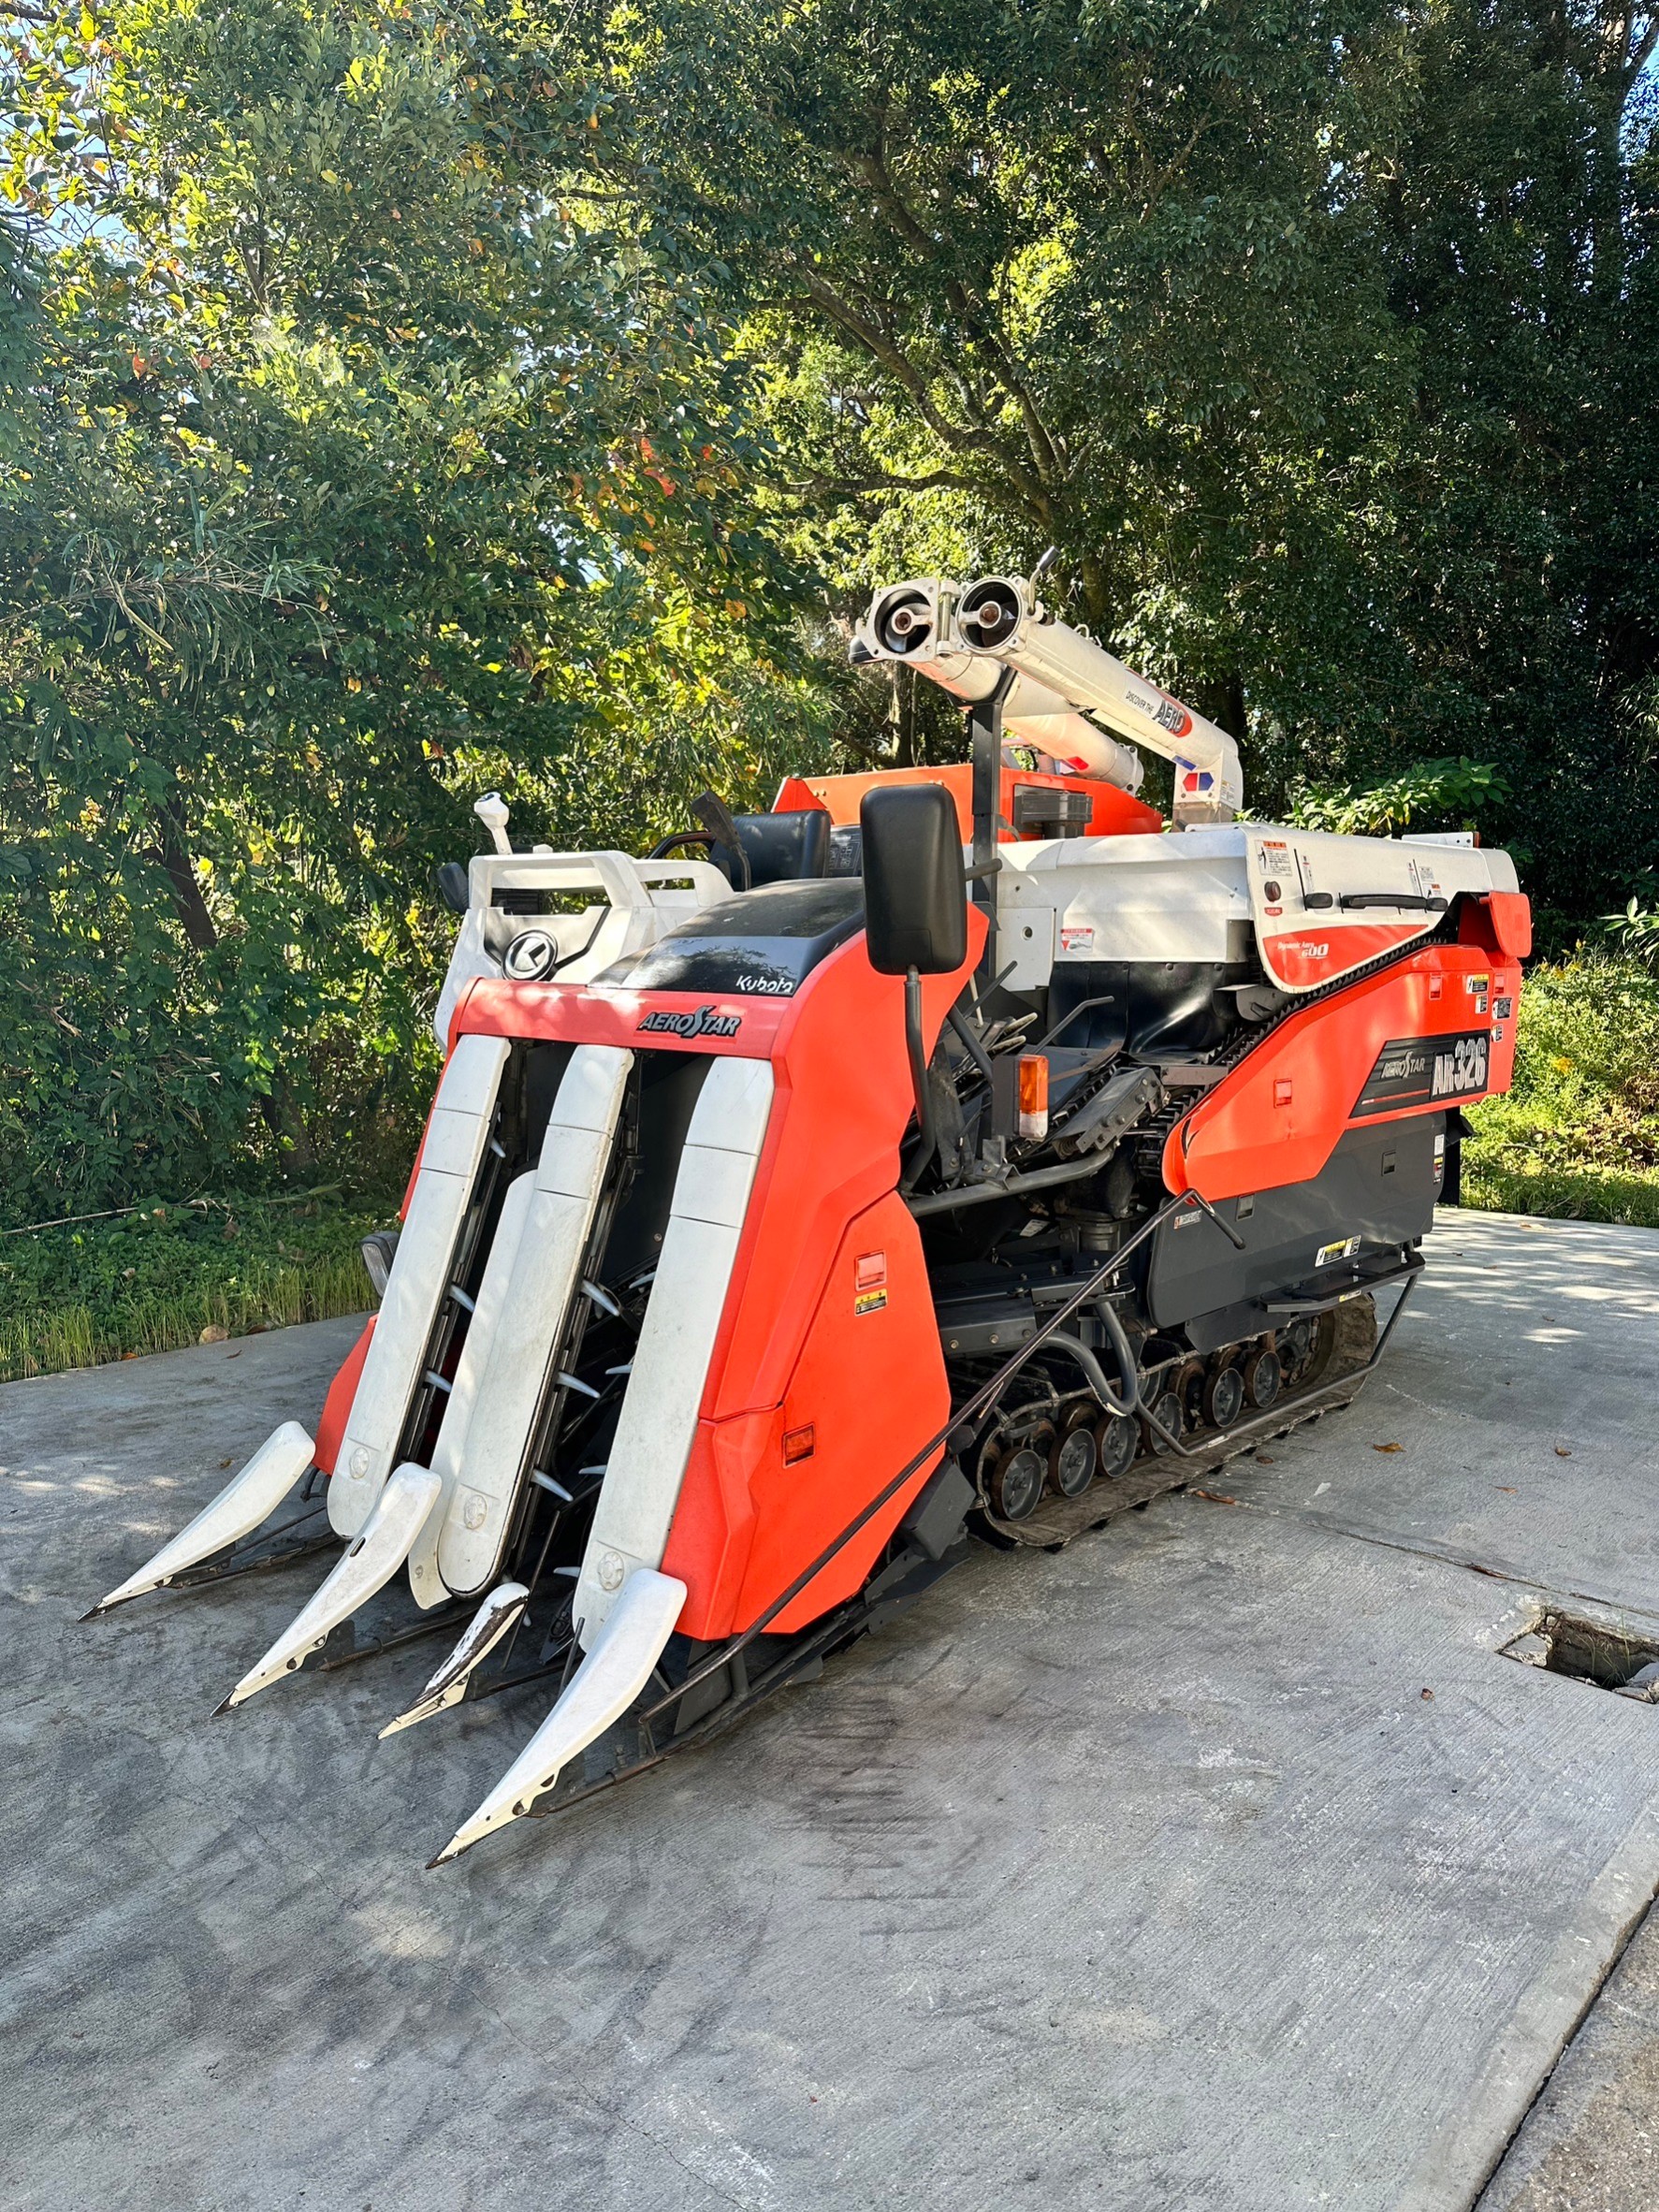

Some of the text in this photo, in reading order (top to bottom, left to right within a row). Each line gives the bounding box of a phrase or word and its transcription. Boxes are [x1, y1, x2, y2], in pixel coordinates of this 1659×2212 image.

[1125, 691, 1186, 734] DISCOVER THE AERO
[735, 975, 793, 993] Kubota
[636, 1005, 742, 1039] AEROSTAR
[1381, 1037, 1487, 1096] AEROSTAR AR326
